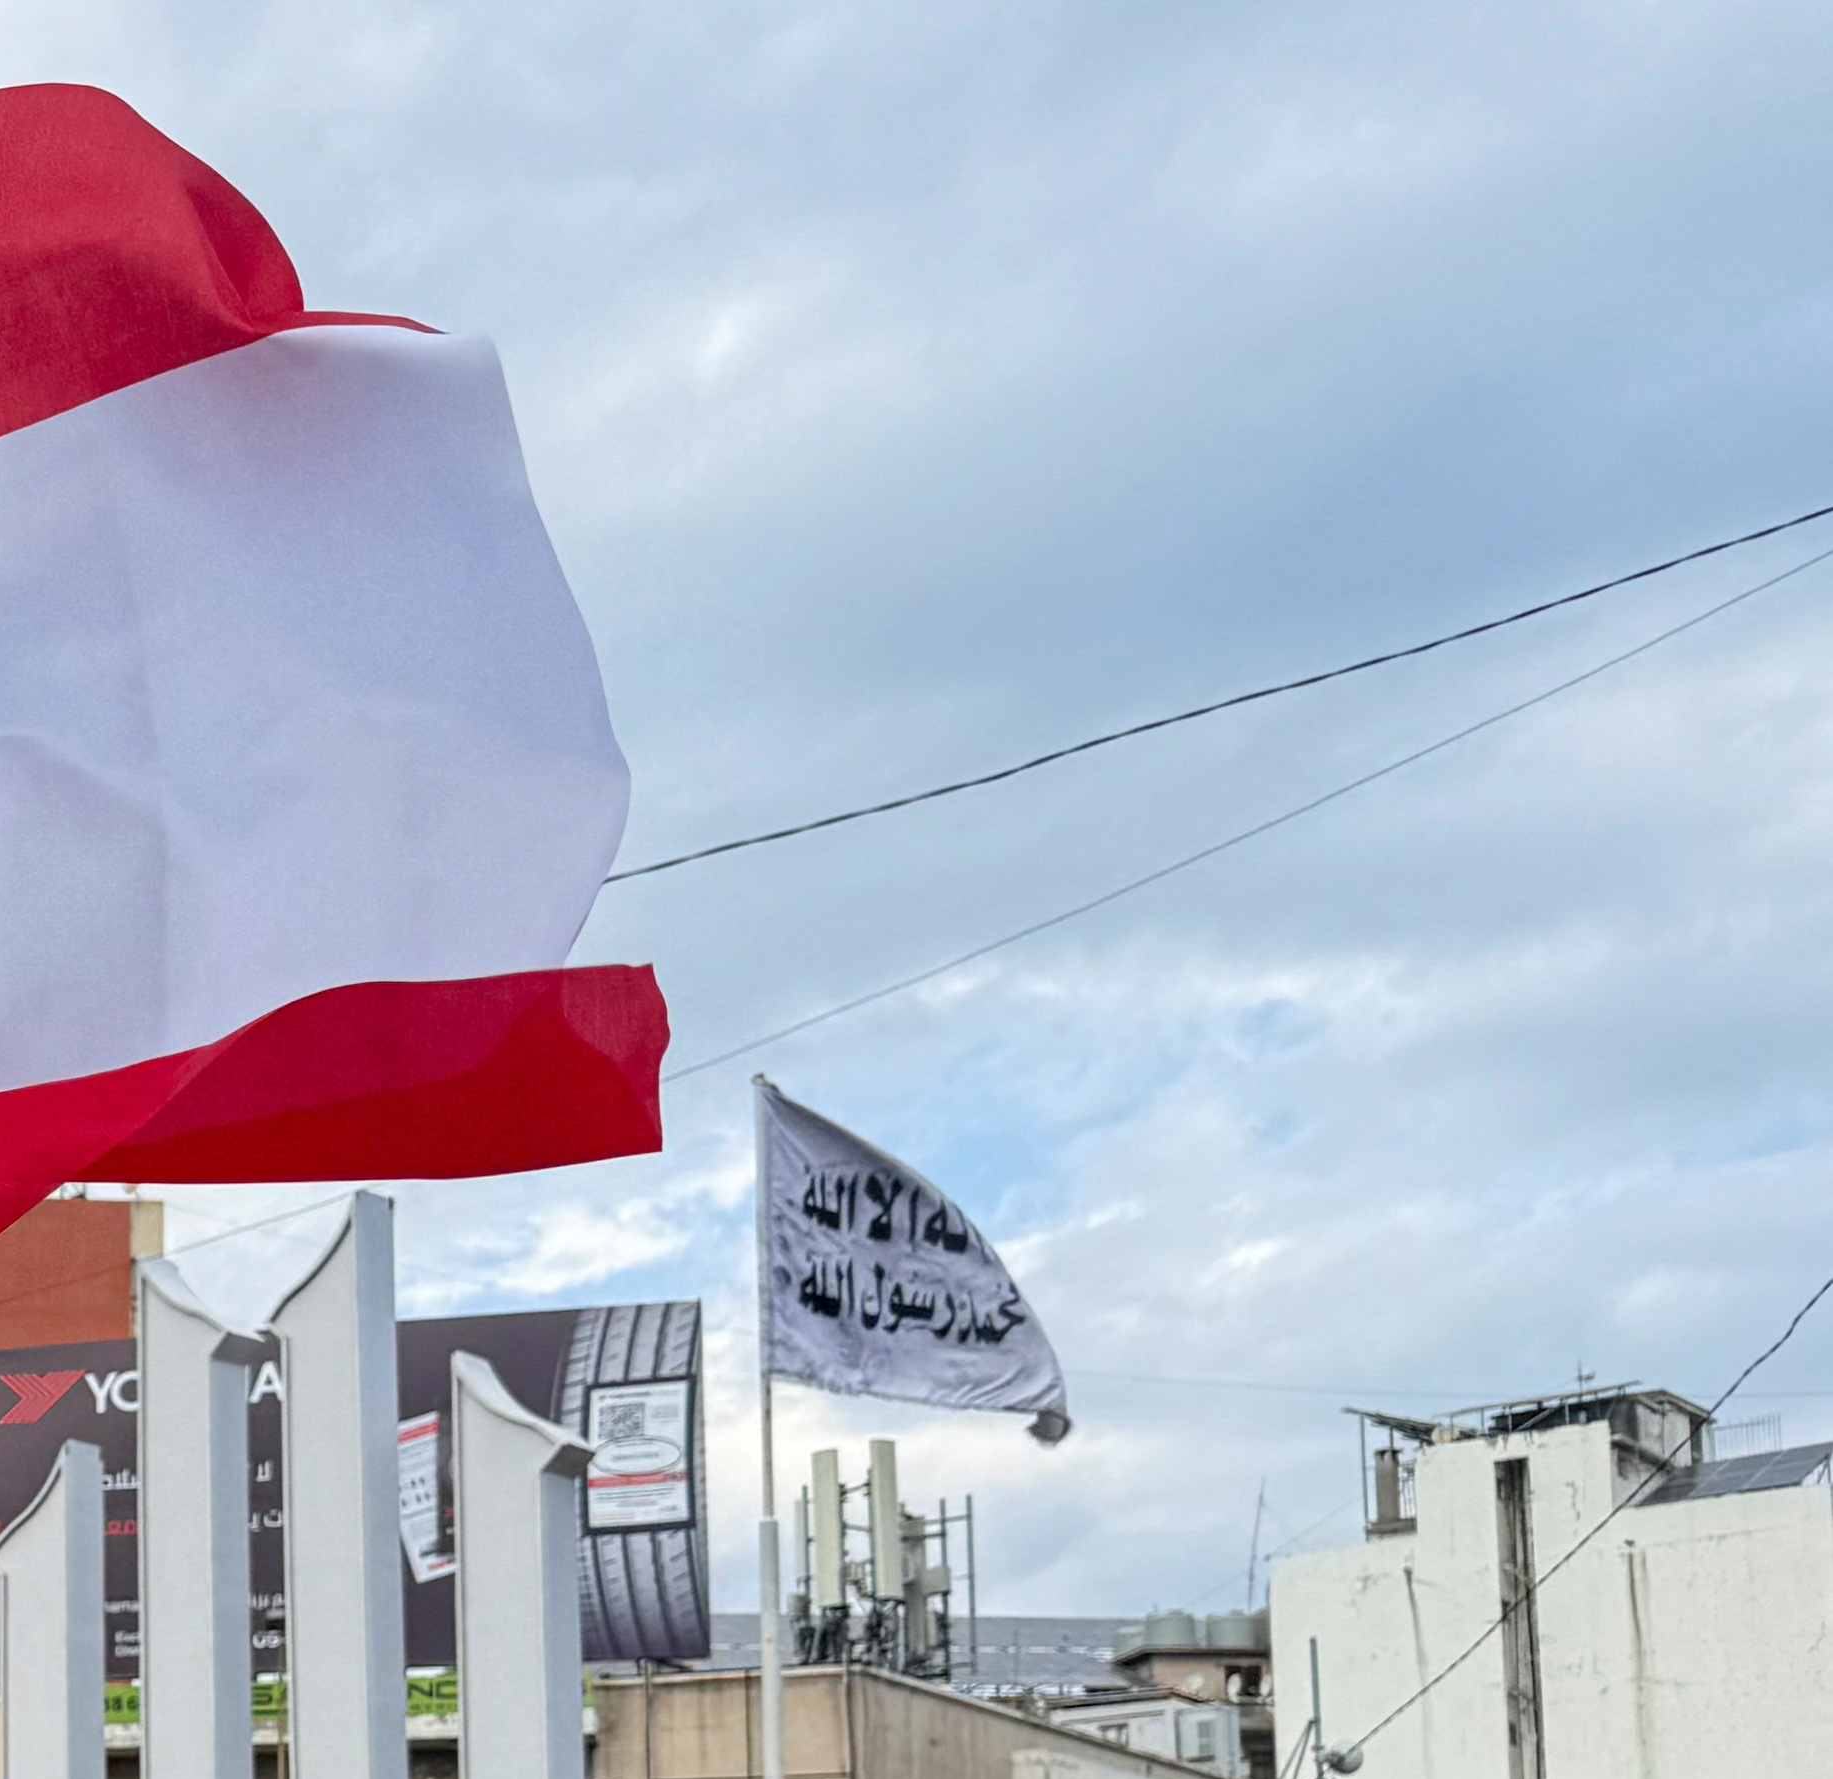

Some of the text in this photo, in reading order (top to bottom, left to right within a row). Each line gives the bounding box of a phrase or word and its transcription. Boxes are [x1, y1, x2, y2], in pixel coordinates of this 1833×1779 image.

[802, 1169, 859, 1232] الله
[798, 1256, 856, 1319] الله
[860, 1262, 955, 1342] رسول
